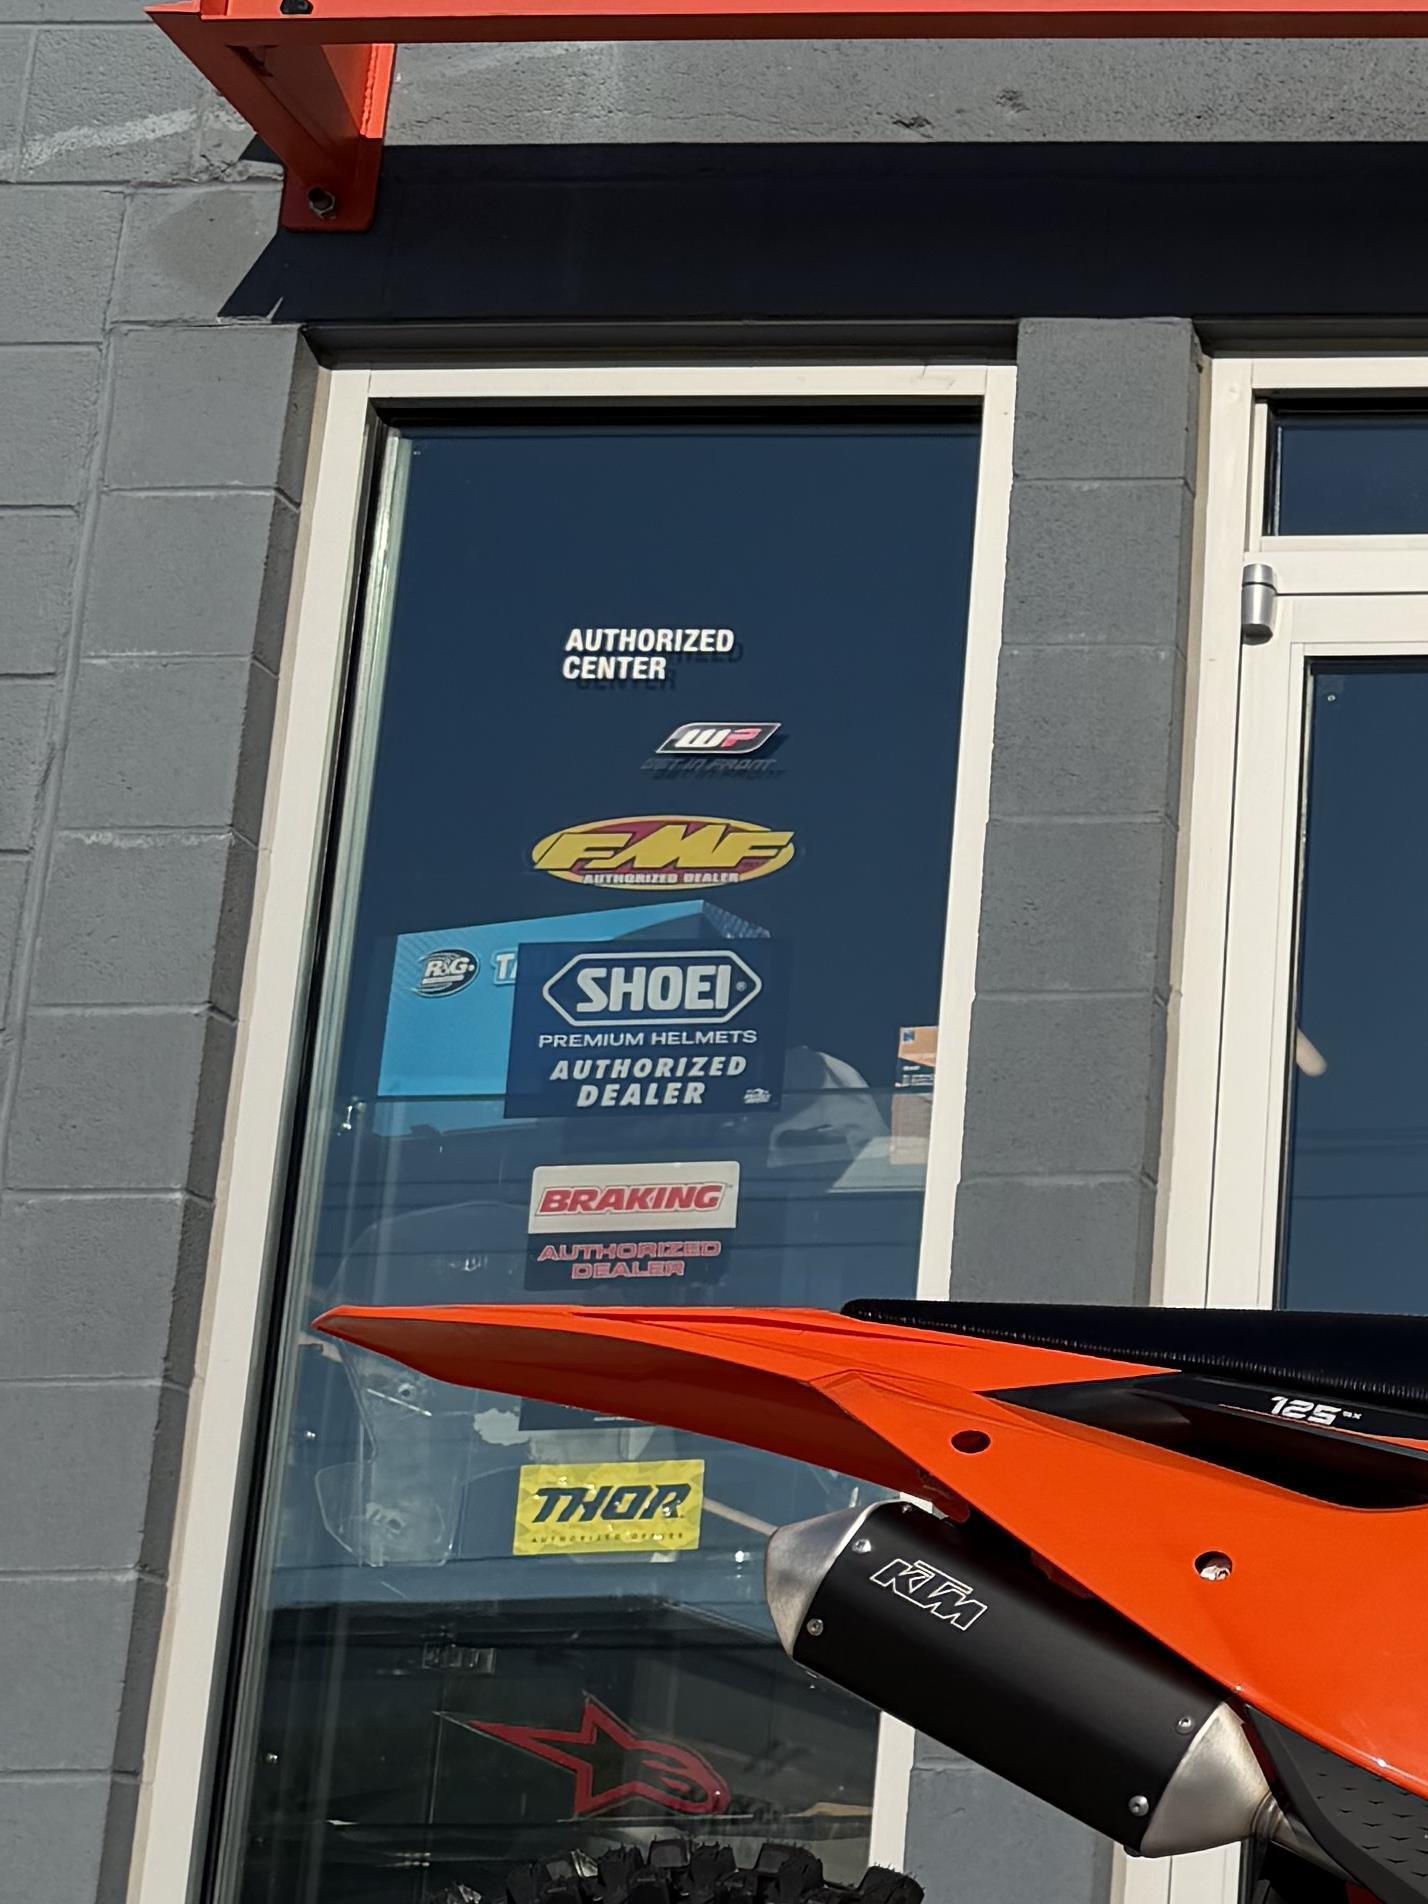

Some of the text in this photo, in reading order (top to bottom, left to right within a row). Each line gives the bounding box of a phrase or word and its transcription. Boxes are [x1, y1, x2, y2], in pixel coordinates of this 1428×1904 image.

[565, 628, 735, 652] AUTHORIZED
[562, 656, 667, 680] CENTER
[674, 728, 762, 748] WP
[533, 823, 795, 870] FMF
[583, 872, 739, 885] AUTHORIZED DEALER
[576, 964, 733, 1013] SHOEI
[538, 1029, 758, 1049] PREMIUM HELMETS
[549, 1055, 748, 1081] AUTHORIZED
[576, 1081, 706, 1108] DEALER
[538, 1184, 724, 1214] BRAKING
[537, 1240, 722, 1262] AUTHORIZED
[571, 1260, 686, 1280] DEALER
[1270, 1395, 1342, 1426] 125
[531, 1482, 692, 1524] THOR
[869, 1558, 989, 1631] KTM
